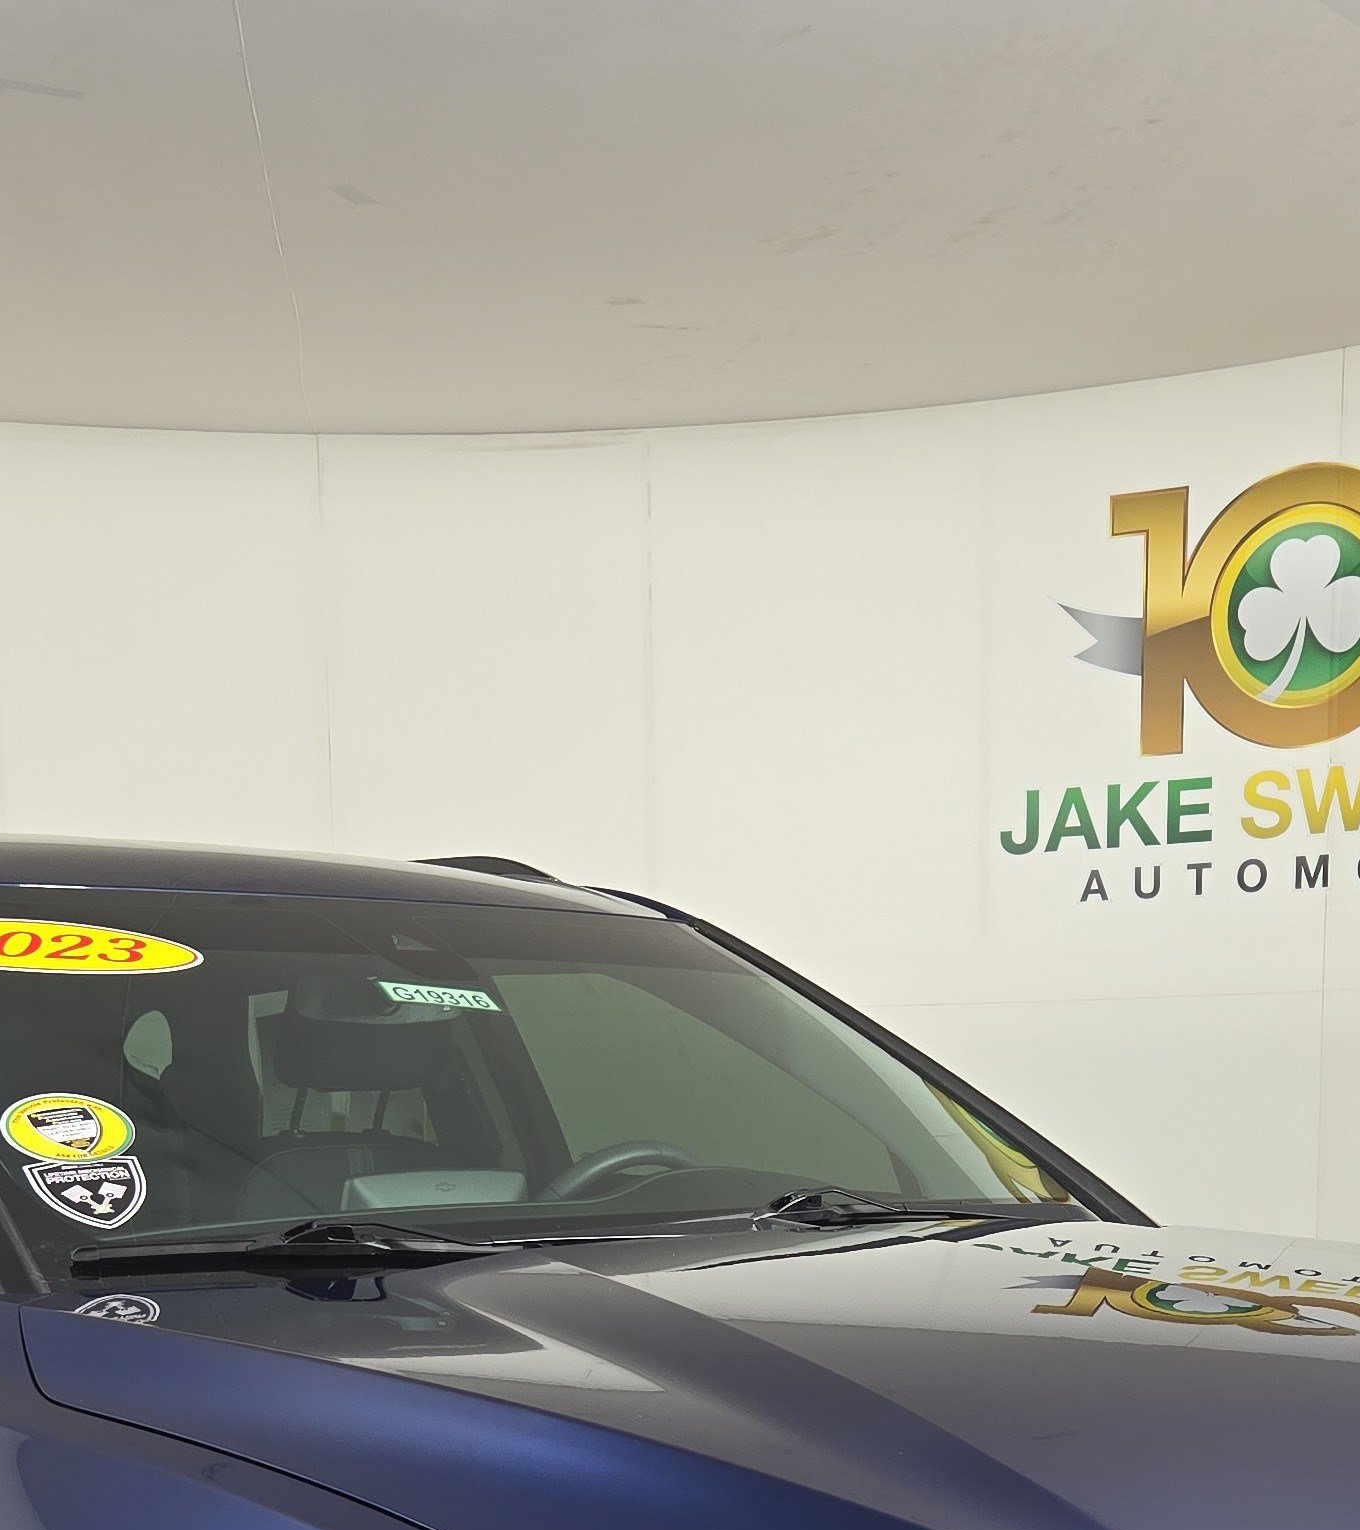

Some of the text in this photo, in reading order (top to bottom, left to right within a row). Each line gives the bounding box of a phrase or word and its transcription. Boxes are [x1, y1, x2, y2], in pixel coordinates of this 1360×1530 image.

[1000, 776, 1214, 856] JAKE
[392, 986, 491, 1008] G19316
[44, 1169, 131, 1184] PROTECTION
